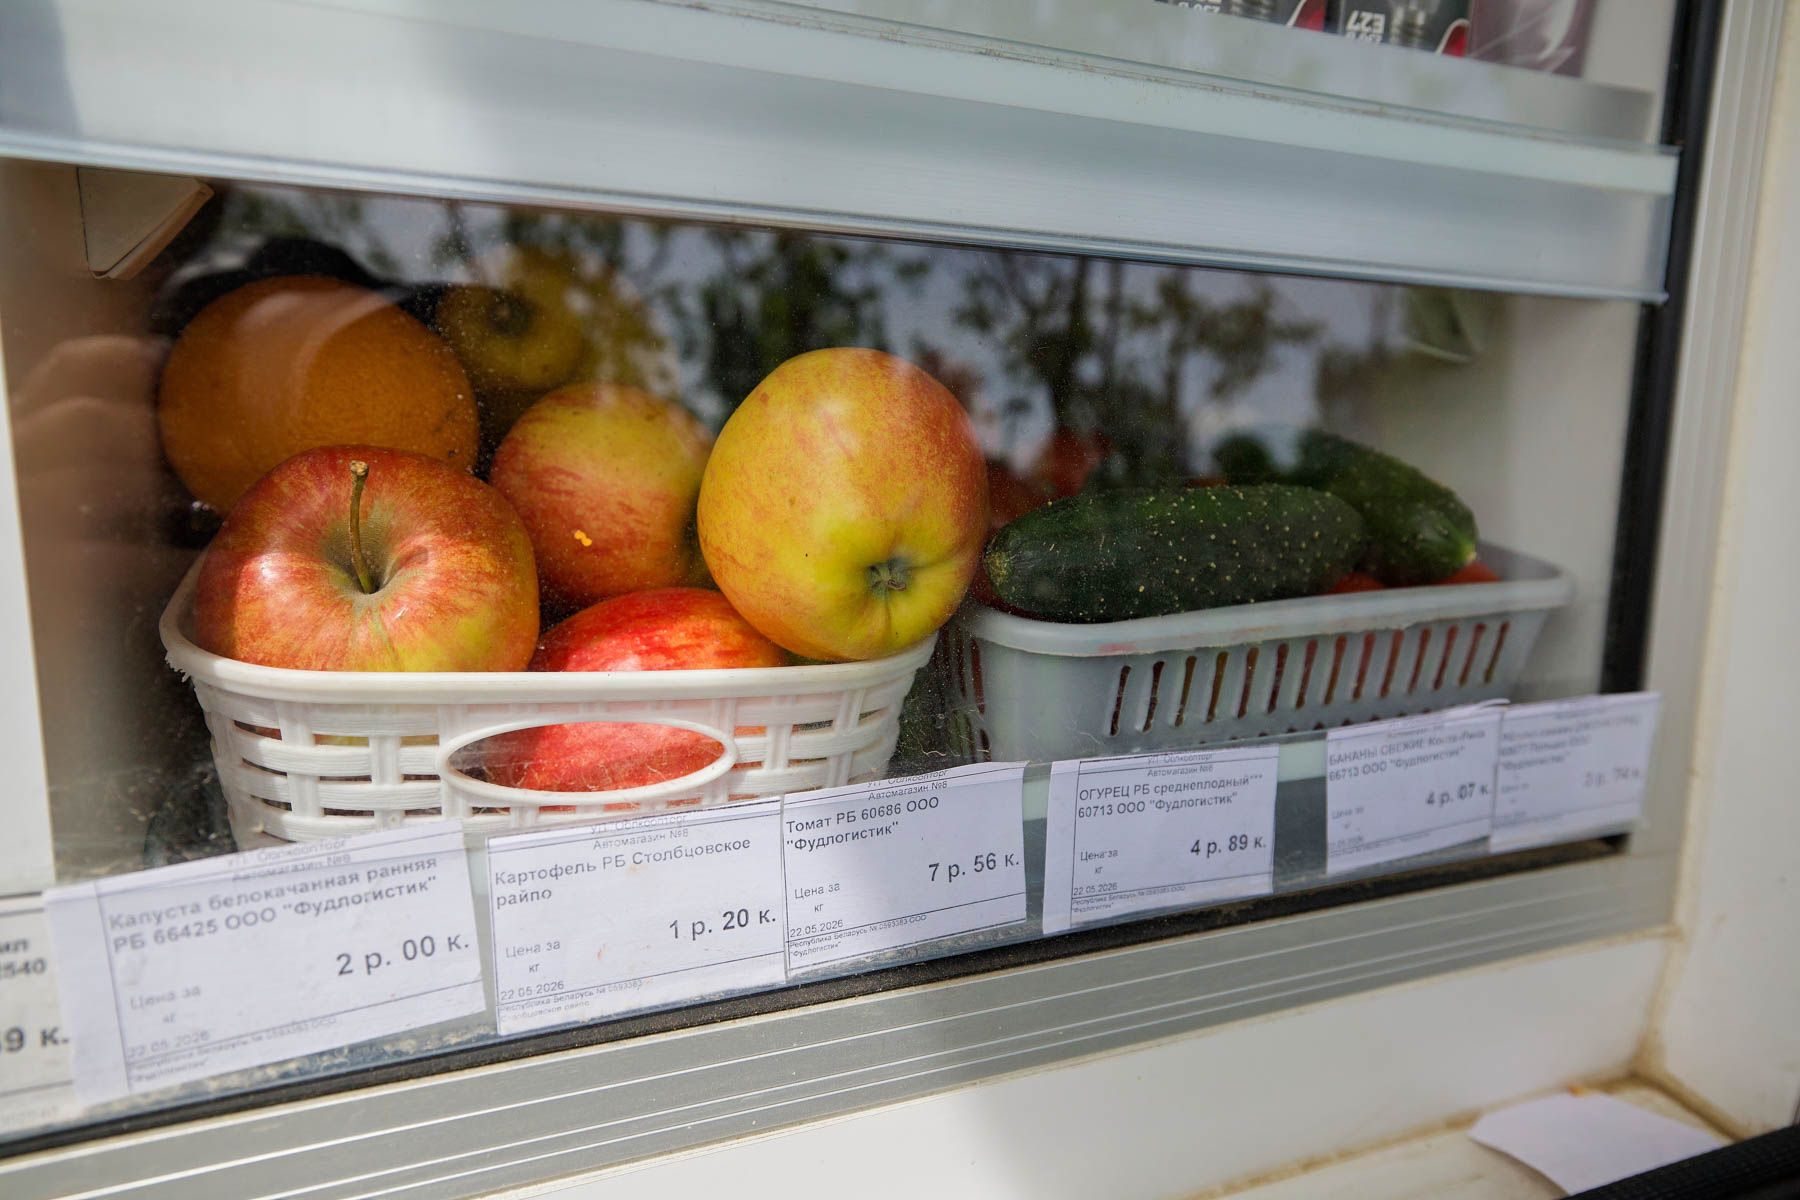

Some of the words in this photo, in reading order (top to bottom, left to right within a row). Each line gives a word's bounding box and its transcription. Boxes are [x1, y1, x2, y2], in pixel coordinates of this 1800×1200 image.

[1329, 748, 1378, 767] БАНАНЫ
[1380, 740, 1423, 757] СВЕЖИЕ
[1362, 761, 1388, 776] ООО
[868, 786, 929, 800] Автомагазин
[931, 781, 948, 790] №8
[1079, 785, 1130, 801] ОГУРЕЦ
[1133, 784, 1150, 796] РБ
[1426, 790, 1436, 806] 4
[1439, 792, 1454, 808] р.
[786, 817, 832, 833] Томат
[836, 811, 857, 824] РБ
[861, 803, 901, 820] 60686
[906, 797, 939, 812] ООО
[1078, 804, 1113, 819] 60713
[1117, 801, 1146, 815] ООО
[1150, 791, 1238, 813] "Фудлогистик"
[593, 833, 666, 850] Автомагазин
[669, 828, 689, 839] №8
[786, 821, 899, 852] "Фудлогистик"
[1190, 839, 1201, 856] 4
[1206, 841, 1222, 859] р.
[1228, 834, 1248, 852] 89
[1254, 836, 1267, 849] к.
[495, 863, 597, 887] Картофель
[602, 855, 626, 870] РБ
[632, 839, 751, 865] Столбцовское
[1080, 851, 1105, 862] Цена
[1107, 849, 1119, 858] за
[929, 862, 940, 882] 7
[948, 863, 966, 883] р.
[974, 852, 996, 873] 56
[1004, 853, 1019, 867] к.
[1095, 866, 1104, 875] кг
[108, 902, 201, 931] Капуста
[208, 873, 360, 911] белокачанная
[366, 857, 438, 883] ранняя
[496, 887, 552, 910] райпо
[794, 886, 824, 899] Цена
[828, 883, 840, 893] за
[113, 933, 145, 953] РБ
[153, 919, 218, 945] 66425
[225, 907, 276, 930] ООО
[282, 875, 437, 917] "Фудлогистик"
[814, 904, 824, 912] кг
[669, 919, 679, 939] 1
[691, 920, 713, 941] р.
[722, 908, 750, 931] 20
[758, 908, 776, 925] к.
[790, 920, 843, 938] 22.05.2026
[336, 953, 354, 977] 2
[365, 952, 391, 976] р.
[402, 935, 436, 961] 00
[447, 934, 470, 952] к.
[505, 943, 541, 959] Цена
[547, 941, 561, 951] за
[0, 958, 47, 978] 540
[528, 963, 540, 973] кг
[129, 992, 176, 1011] Цена
[182, 986, 202, 998] за
[0, 1025, 25, 1053] 9
[40, 1025, 70, 1048] к.
